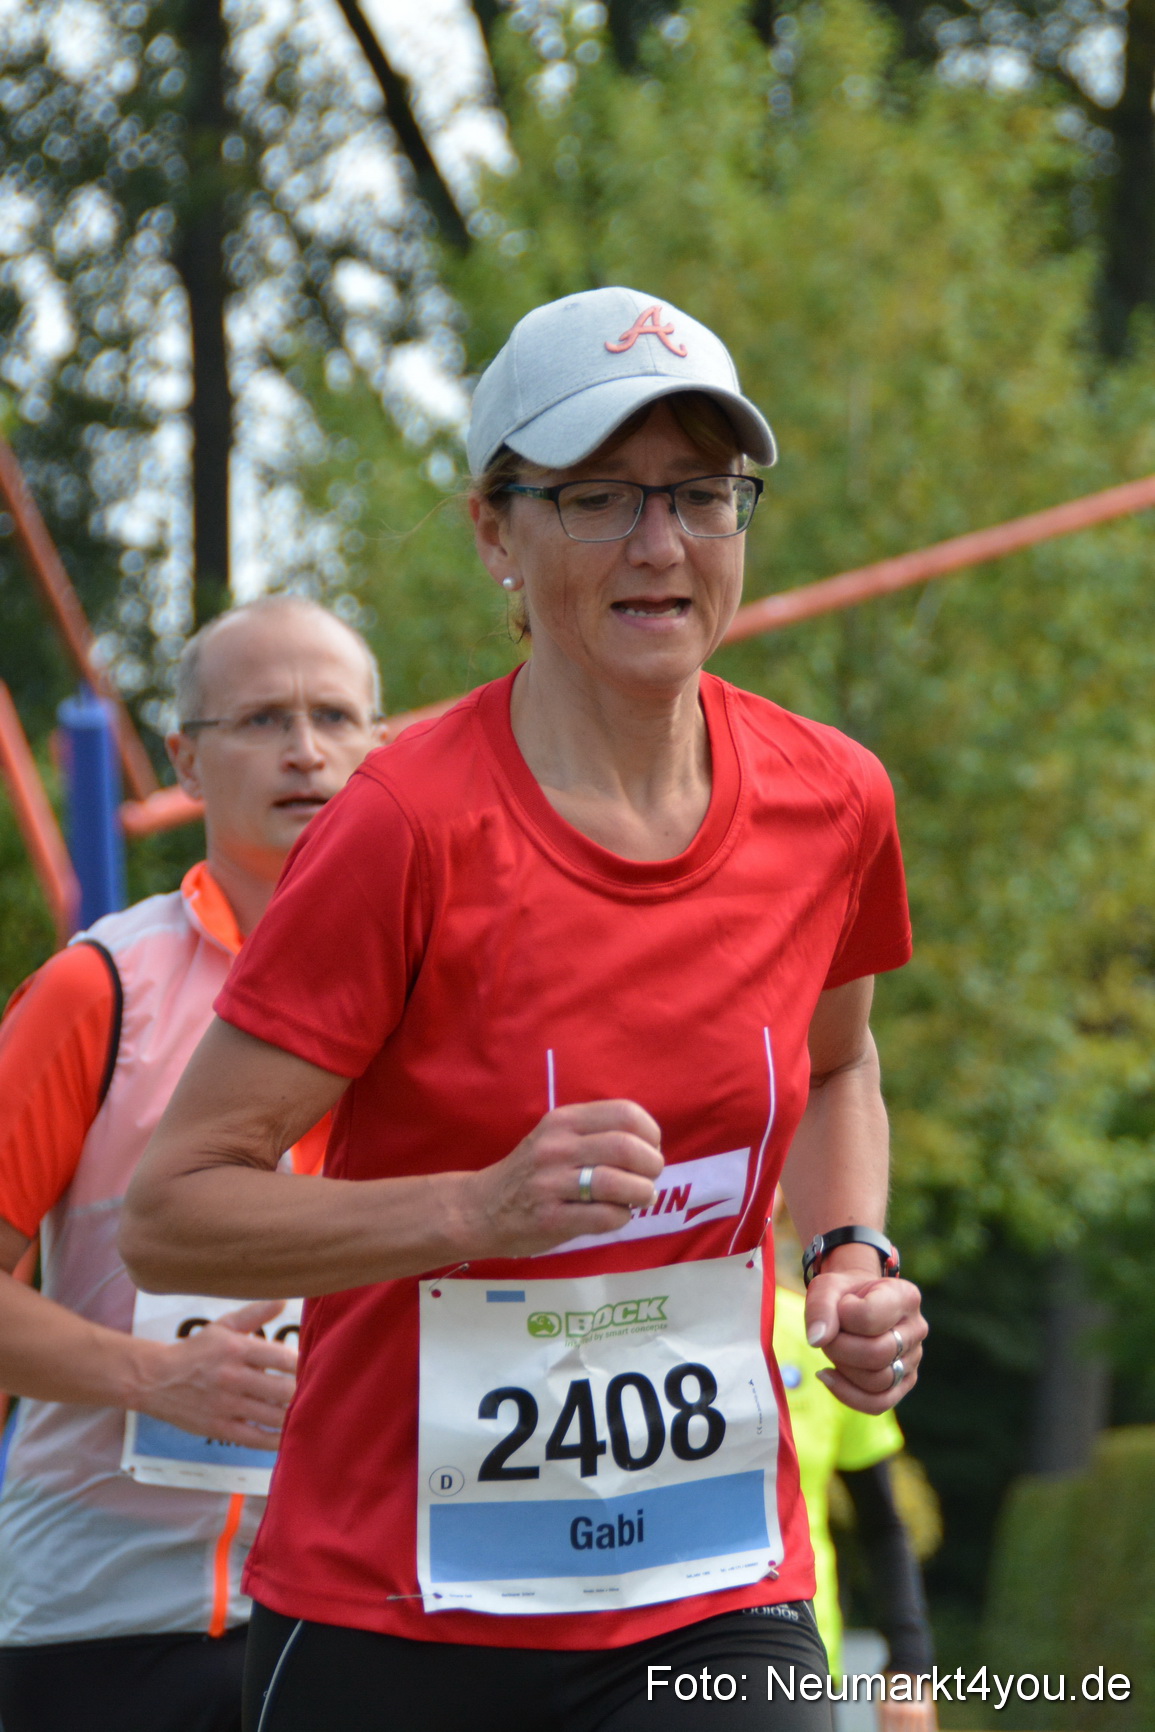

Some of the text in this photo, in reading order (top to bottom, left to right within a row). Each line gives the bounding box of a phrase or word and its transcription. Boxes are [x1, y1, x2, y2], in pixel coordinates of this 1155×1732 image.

[604, 305, 688, 358] A
[565, 1295, 669, 1338] BOCK
[477, 1362, 727, 1482] 2408
[440, 1474, 453, 1491] D
[569, 1508, 645, 1551] Gabi
